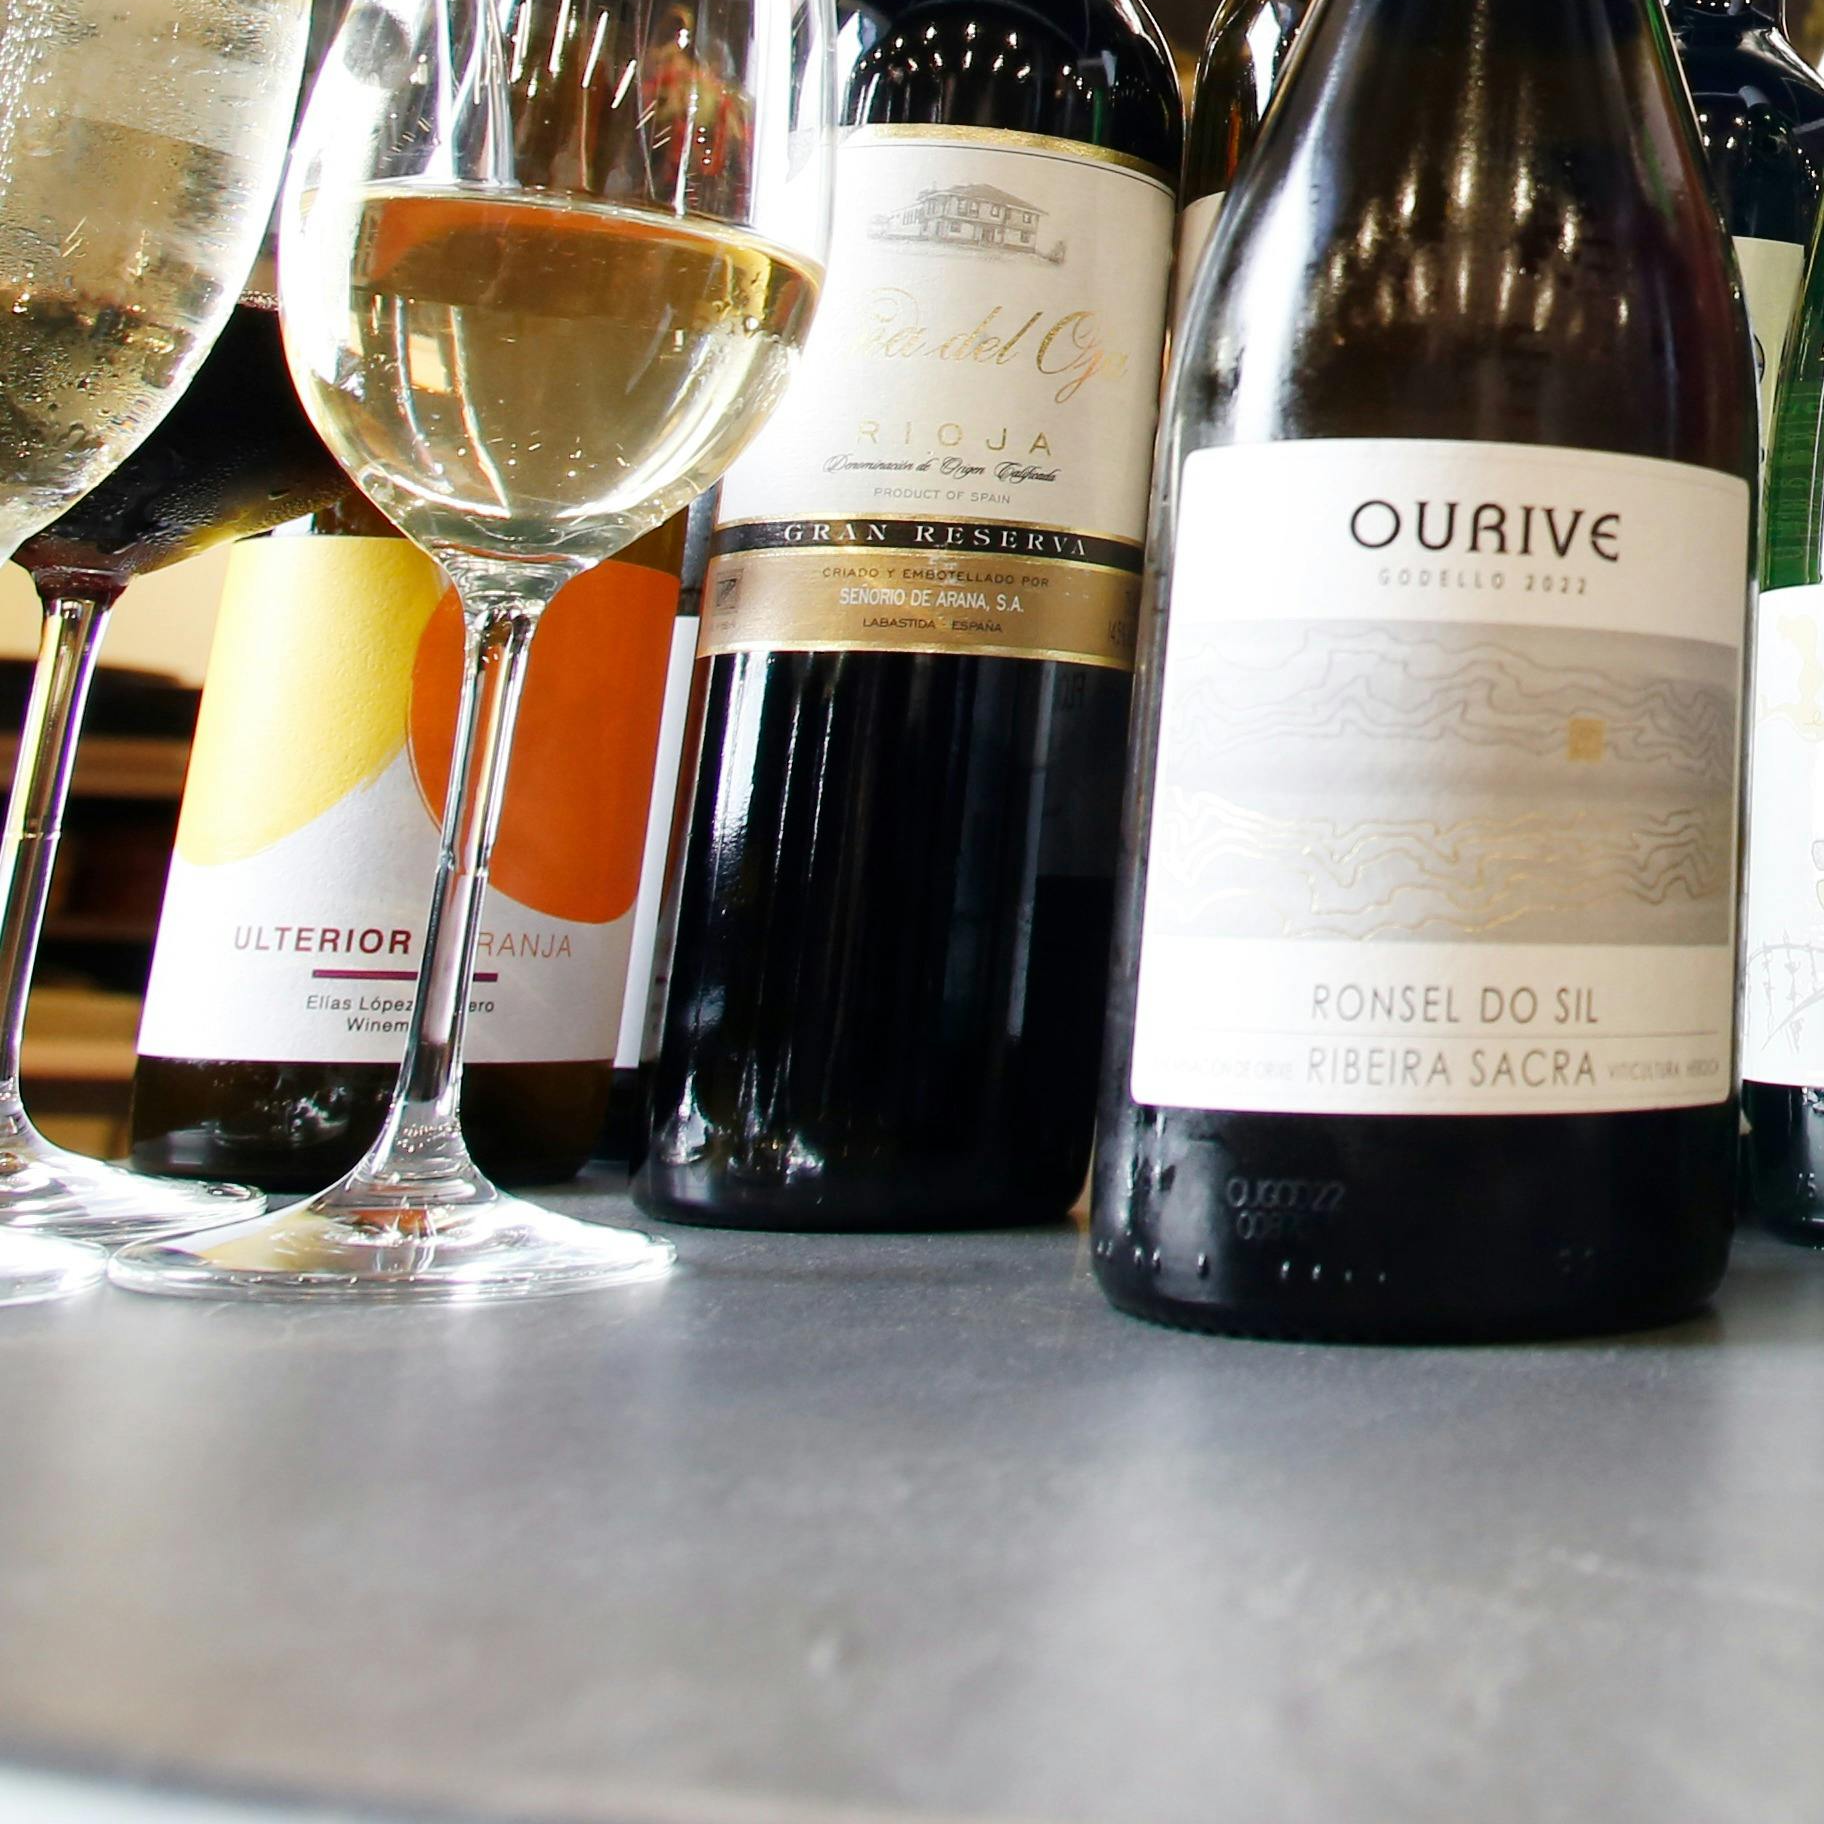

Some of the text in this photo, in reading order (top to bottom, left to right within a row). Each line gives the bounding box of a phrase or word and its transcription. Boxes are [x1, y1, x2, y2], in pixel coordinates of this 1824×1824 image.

[857, 420, 1052, 457] RIOJA
[873, 486, 1011, 505] PRODUCT OF SPAIN
[784, 523, 1087, 556] GRAN RESERVA
[1350, 499, 1620, 562] OURIVE
[822, 567, 1049, 588] CRIADO Y EMBOTELLADO POR
[1377, 569, 1587, 595] GODELLO 2022
[911, 589, 932, 607] DE
[935, 591, 991, 611] ARANA,
[996, 594, 1024, 613] S.A.
[862, 617, 936, 630] LABASTIDA
[234, 926, 412, 955] ULTERIOR
[306, 993, 413, 1015] Elías López
[1312, 983, 1598, 1025] RONSEL DO SIL
[1305, 1046, 1597, 1088] RIBEIRA SACRA
